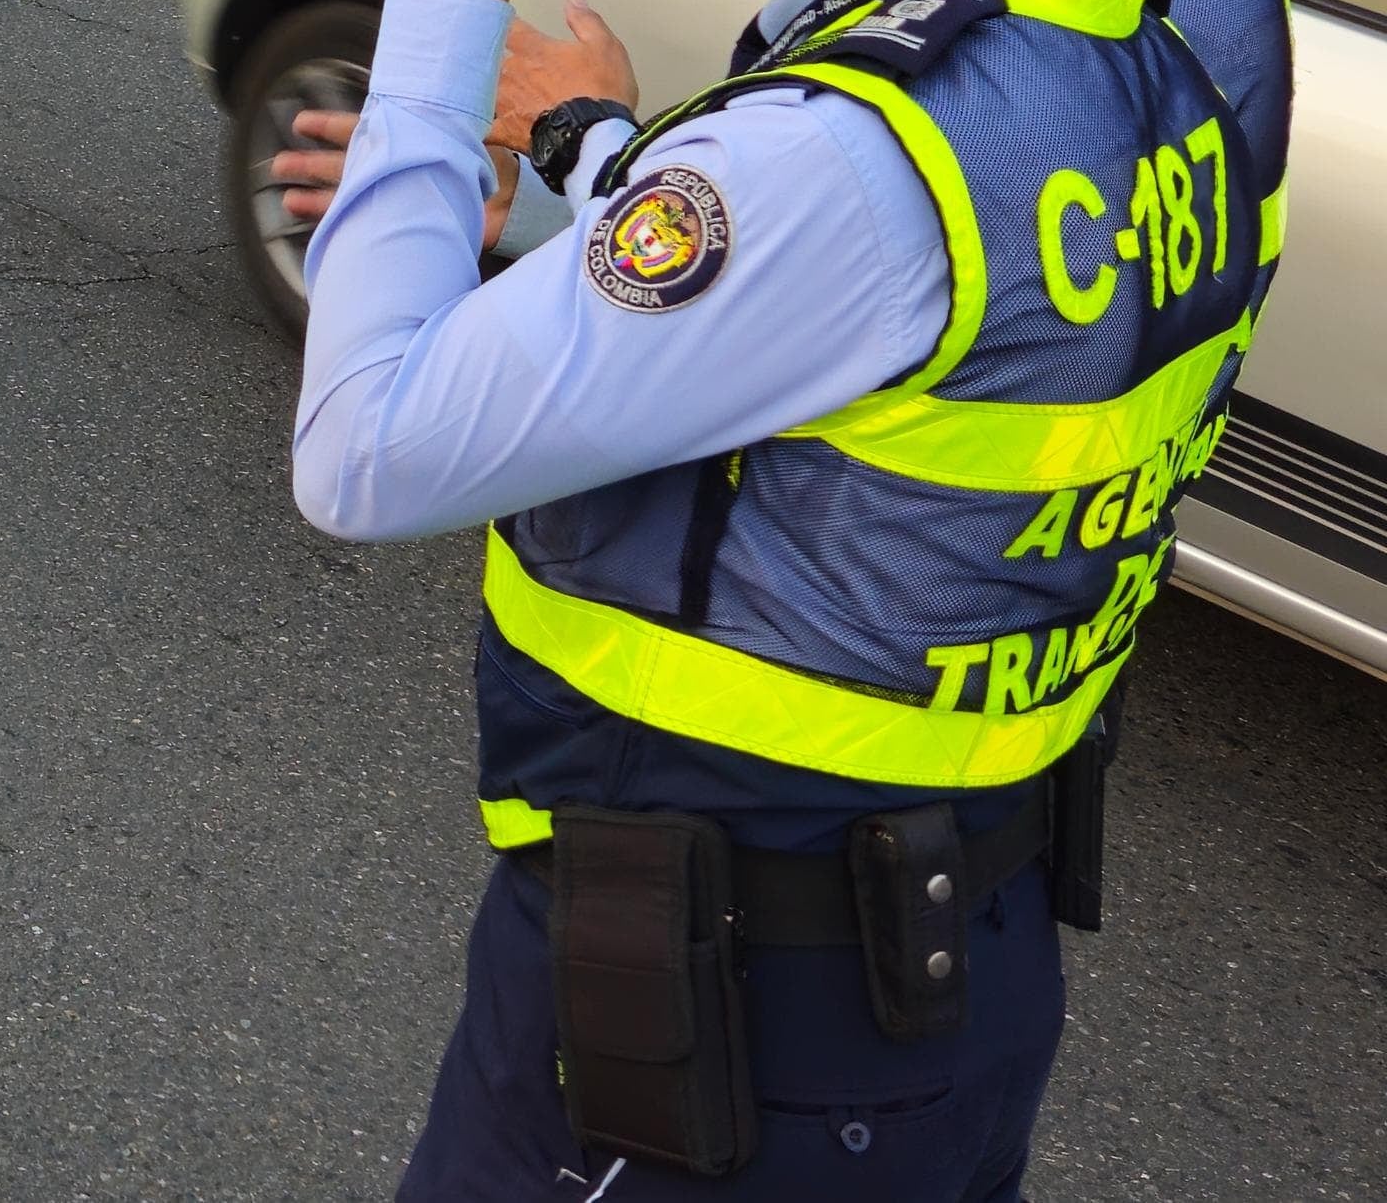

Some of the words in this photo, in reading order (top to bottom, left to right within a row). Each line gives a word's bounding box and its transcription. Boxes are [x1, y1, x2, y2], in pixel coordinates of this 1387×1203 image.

[592, 219, 612, 242] DE
[1038, 117, 1227, 326] C-187
[589, 244, 663, 307] COLOMBIA
